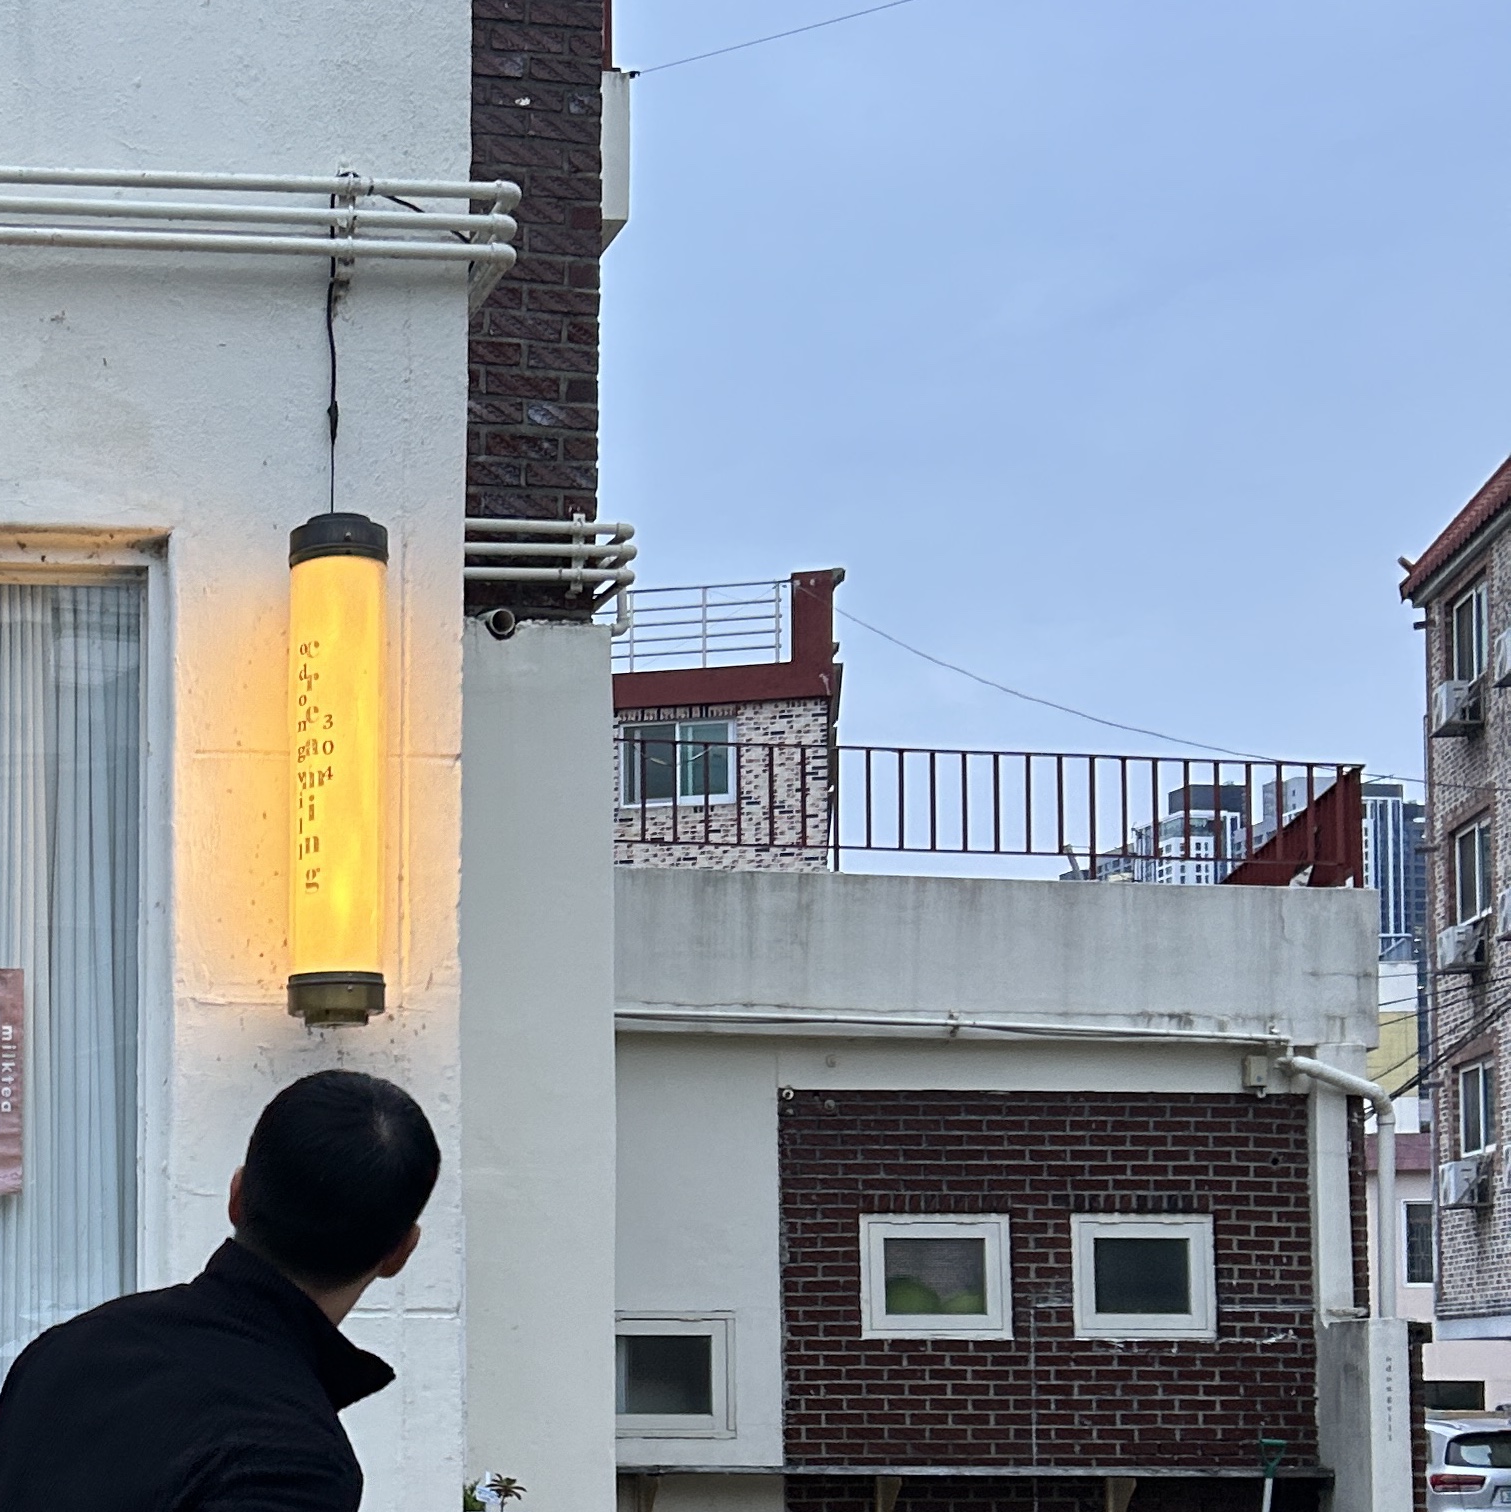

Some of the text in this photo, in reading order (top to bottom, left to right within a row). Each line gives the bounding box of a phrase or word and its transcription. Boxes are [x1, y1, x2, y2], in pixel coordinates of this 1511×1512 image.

[297, 643, 308, 861] odongvill
[322, 713, 335, 781] 304
[1, 1024, 16, 1113] milktea
